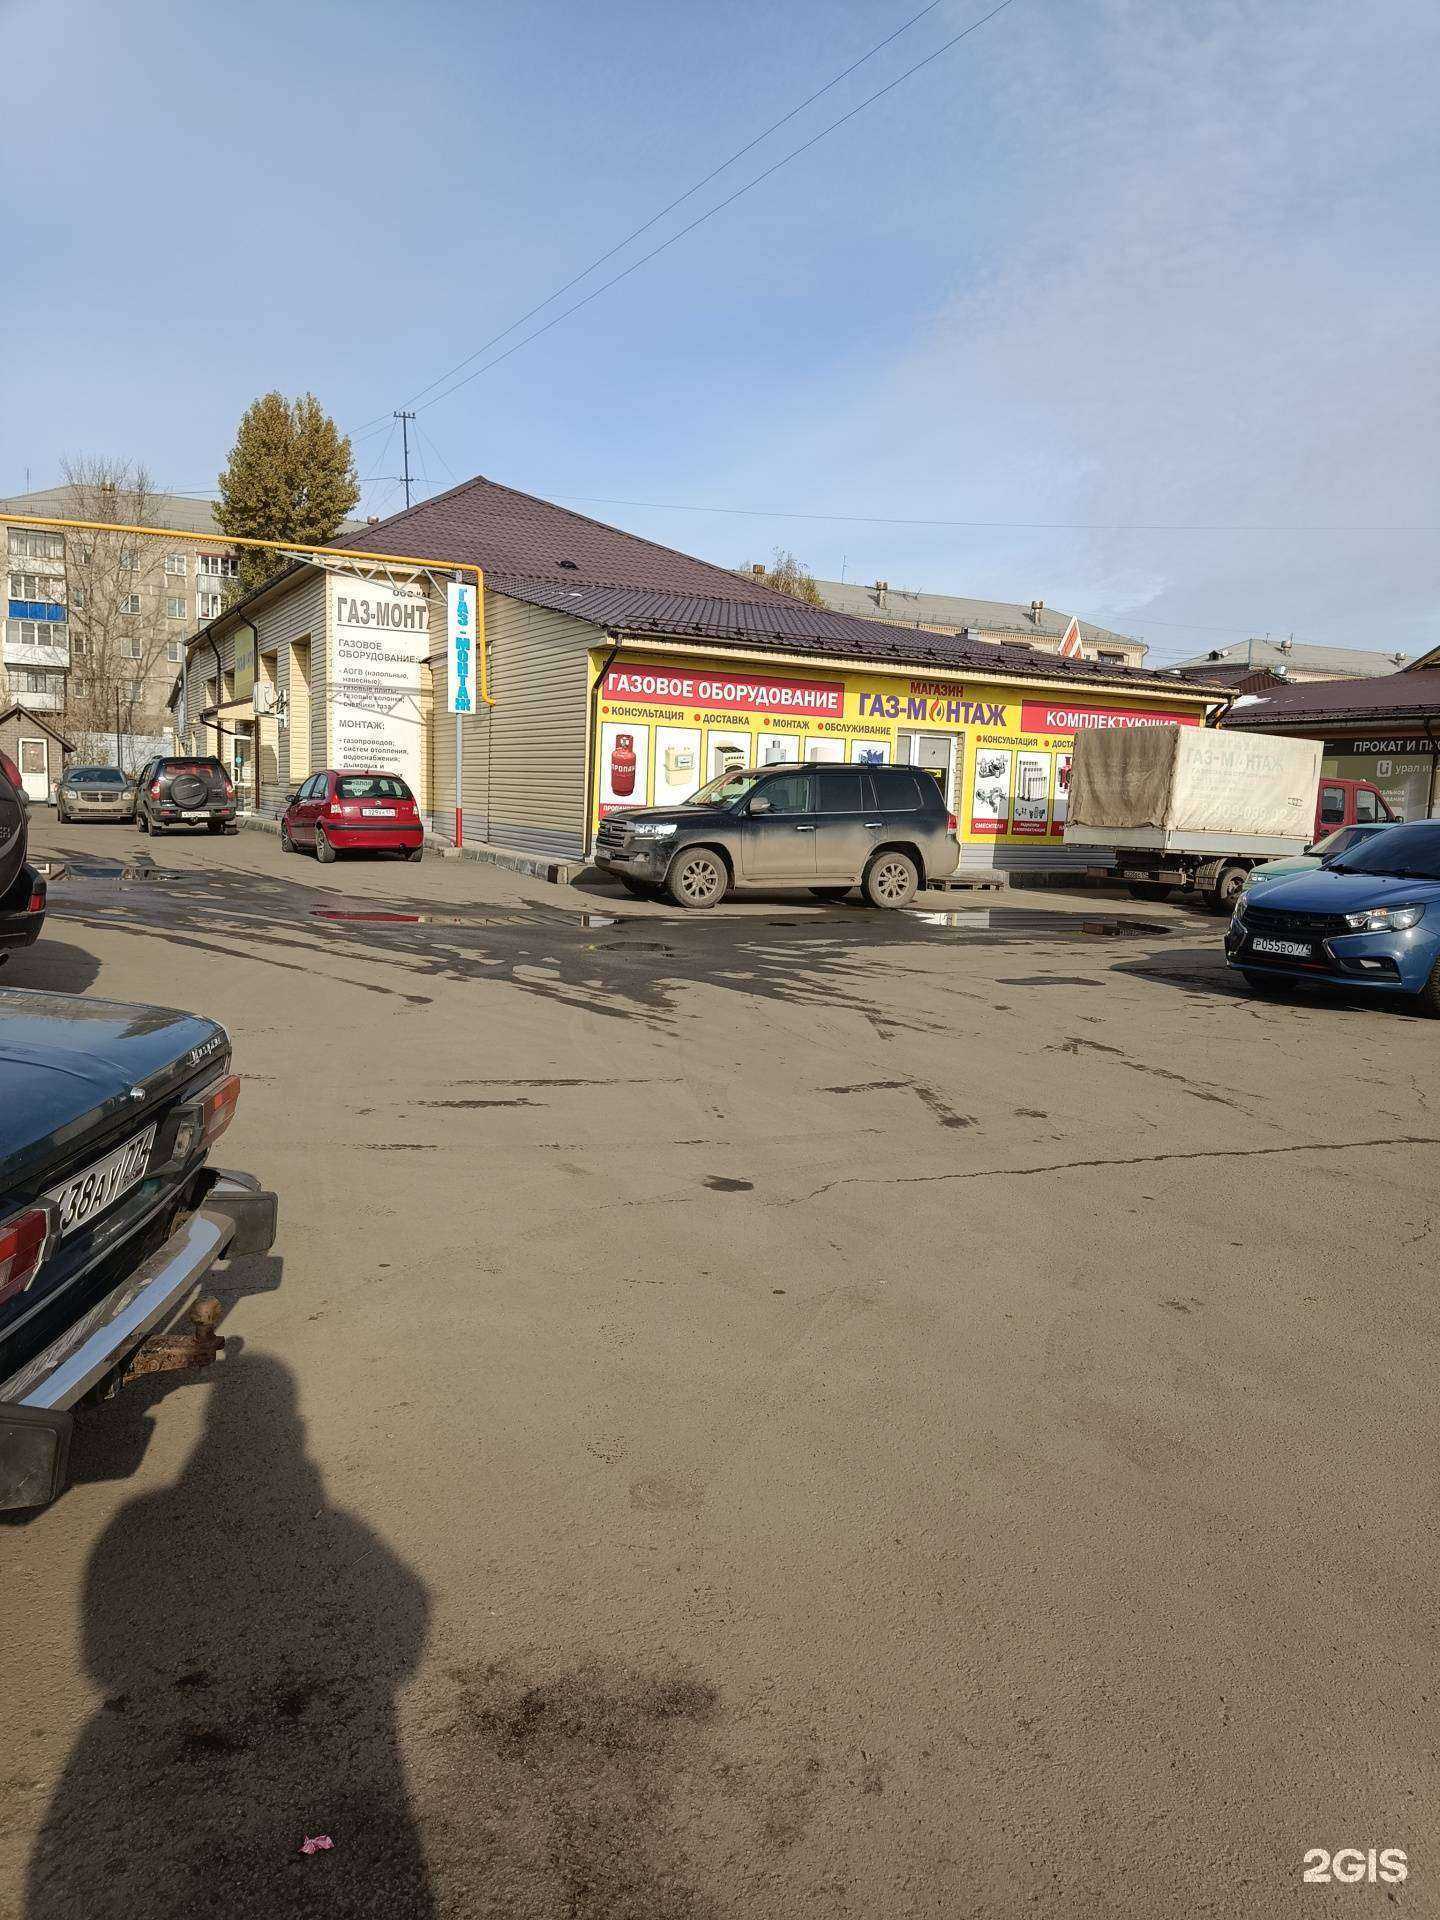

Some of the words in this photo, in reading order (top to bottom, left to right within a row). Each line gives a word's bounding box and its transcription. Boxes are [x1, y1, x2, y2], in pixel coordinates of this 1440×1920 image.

[338, 639, 382, 650] ГАЗОВОЕ
[608, 673, 694, 698] ГАЗОВОЕ
[698, 681, 838, 709] ОБОРУДОВАНИЕ
[910, 681, 964, 697] МАГАЗИН
[611, 706, 684, 721] КОНСУЛЬТАЦИЯ
[702, 713, 750, 726] ДОСТАВКА
[772, 719, 810, 730] МОНТАЖ
[825, 722, 891, 736] ОБСЛУЖИВАНИЕ
[982, 735, 1038, 747] КОНСУЛЬТАЦИЯ
[1051, 740, 1074, 749] ДОСТА
[1353, 740, 1404, 752] ПРОКАТ
[1406, 740, 1416, 751] И
[1394, 764, 1420, 775] урал
